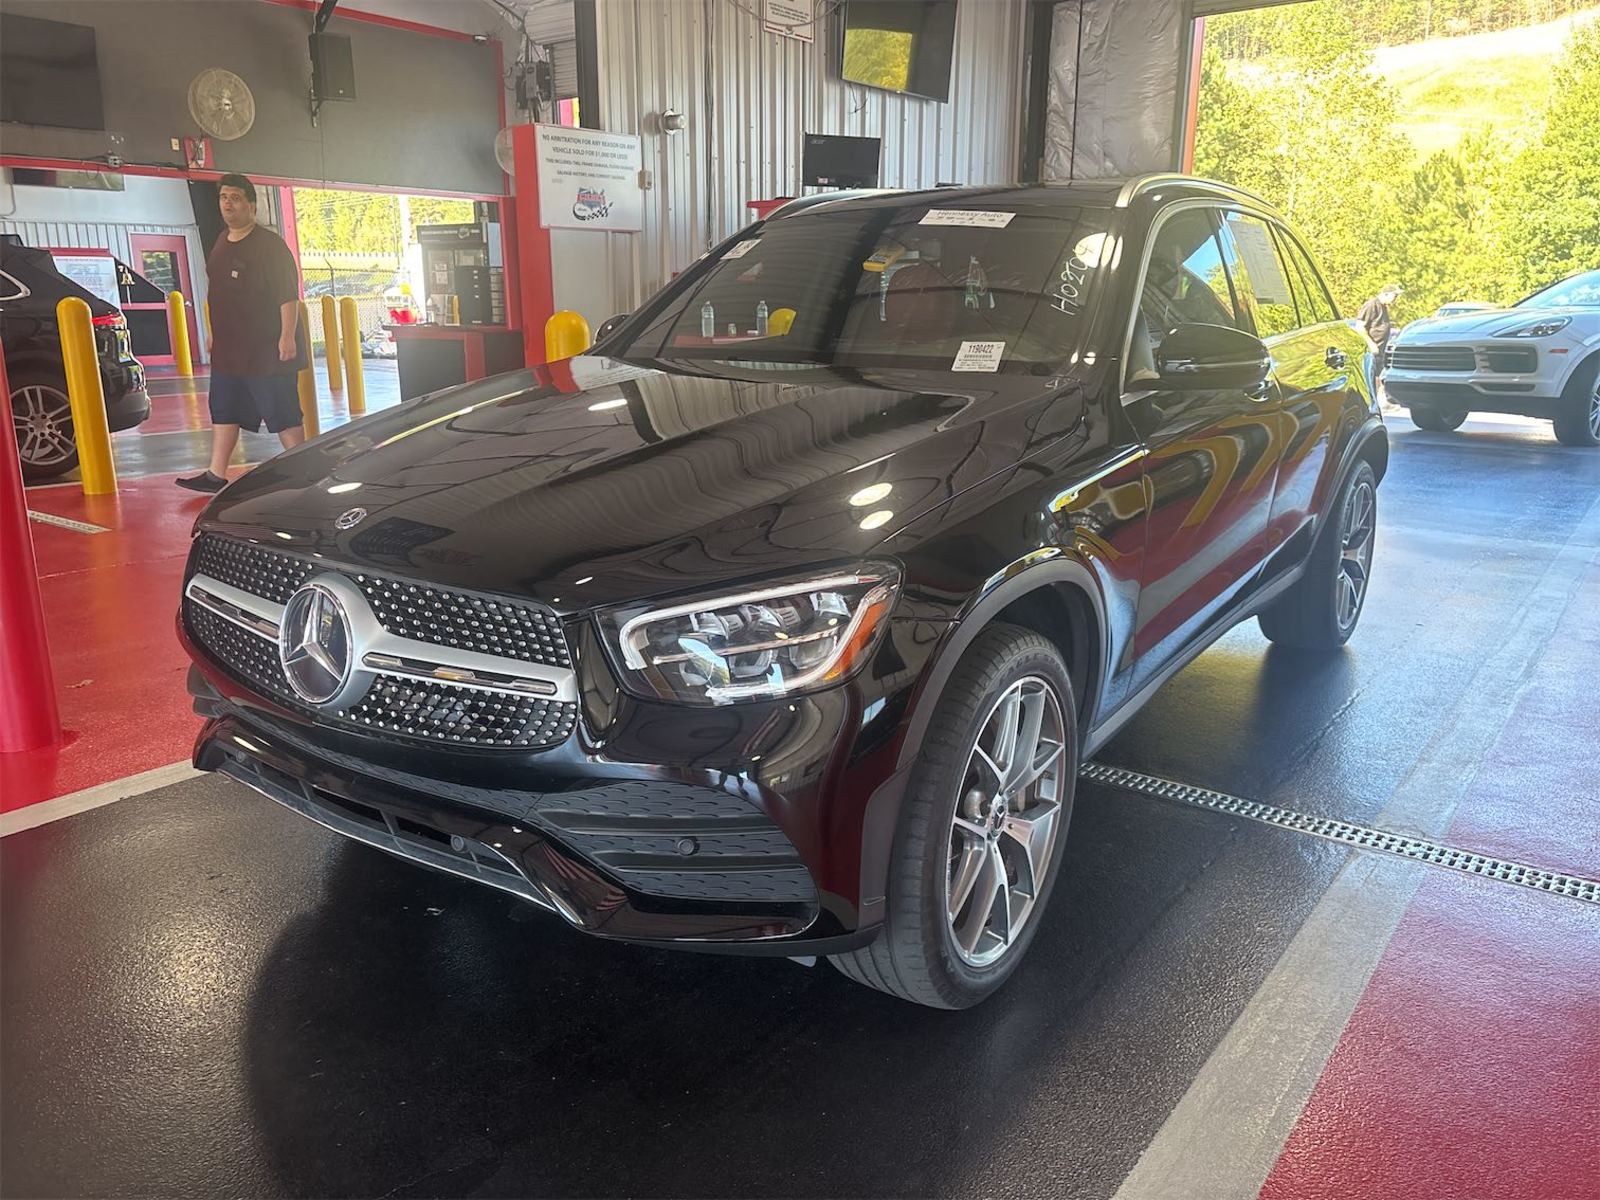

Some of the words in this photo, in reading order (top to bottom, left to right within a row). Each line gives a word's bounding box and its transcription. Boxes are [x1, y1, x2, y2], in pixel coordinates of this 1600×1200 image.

[550, 135, 581, 145] ARBITRATION
[582, 138, 592, 146] FOR
[602, 140, 619, 149] REASON
[552, 146, 572, 155] VEHICLE
[572, 148, 585, 156] SOLD
[967, 343, 995, 354] 1190422
